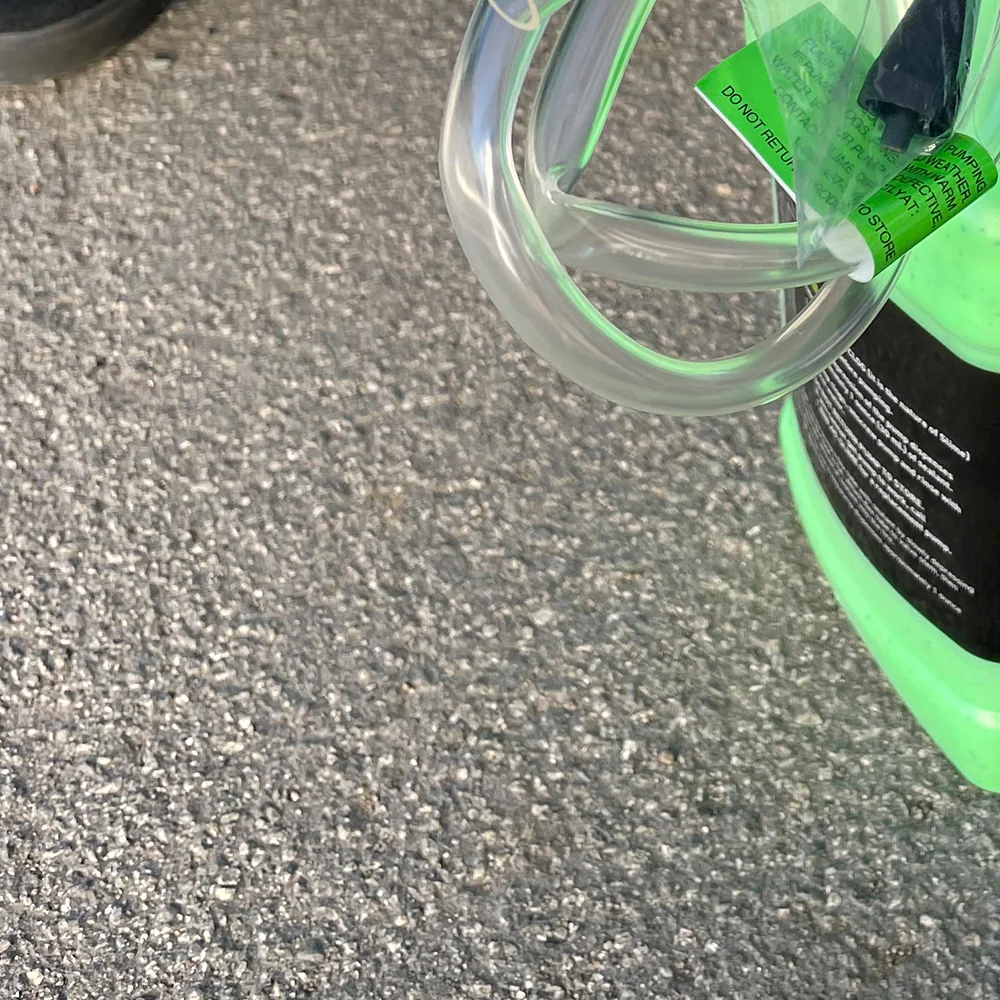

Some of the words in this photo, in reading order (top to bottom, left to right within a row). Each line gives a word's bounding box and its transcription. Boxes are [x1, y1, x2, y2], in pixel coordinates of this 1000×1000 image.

[721, 85, 742, 105] DO
[738, 103, 766, 129] NOT
[761, 129, 795, 172] RETU
[868, 214, 896, 262] STORE
[931, 174, 958, 212] WARM
[943, 144, 987, 193] PUMPING
